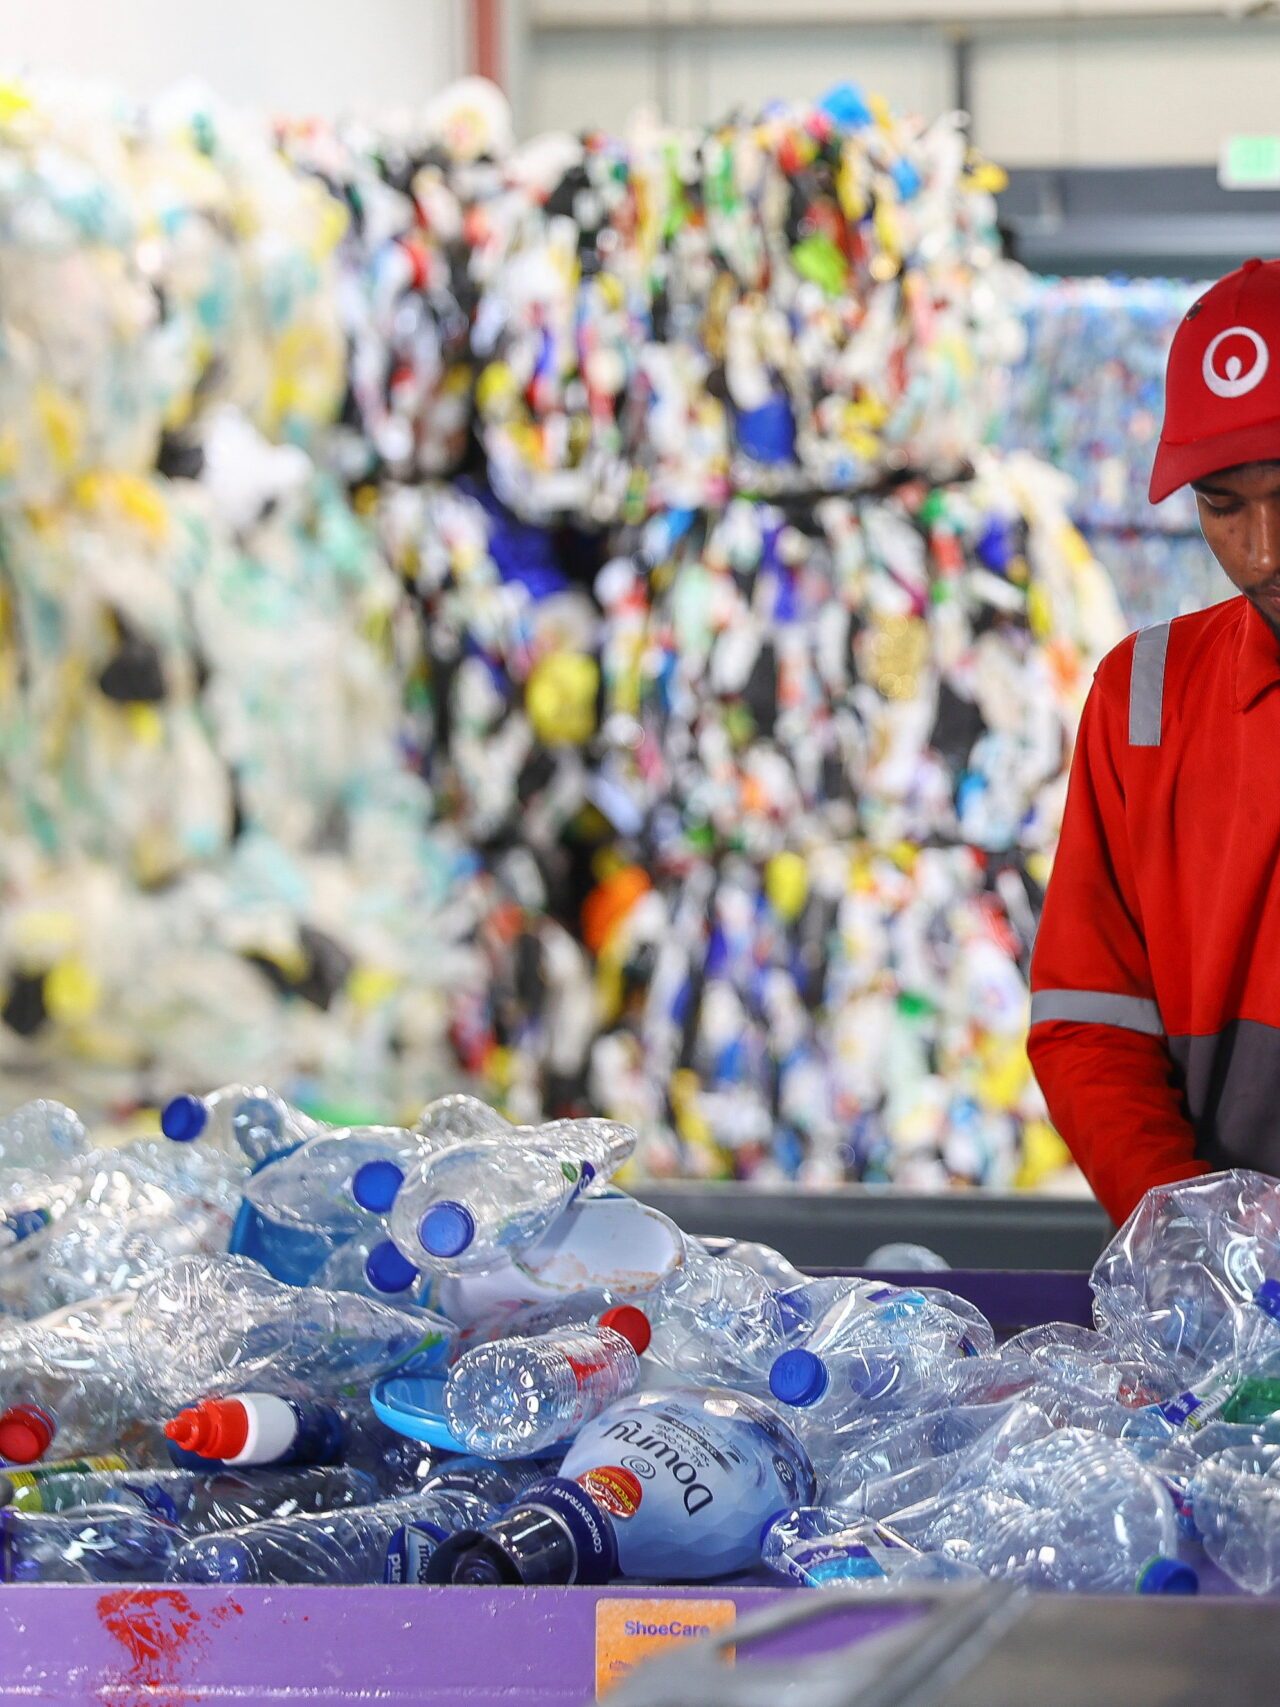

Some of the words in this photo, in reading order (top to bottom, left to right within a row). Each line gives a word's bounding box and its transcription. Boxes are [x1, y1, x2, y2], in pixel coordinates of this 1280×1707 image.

[600, 1419, 714, 1517] Downy
[552, 1487, 603, 1554] CONCENTRATE
[387, 1553, 402, 1584] pur
[623, 1619, 711, 1638] ShoeCare
